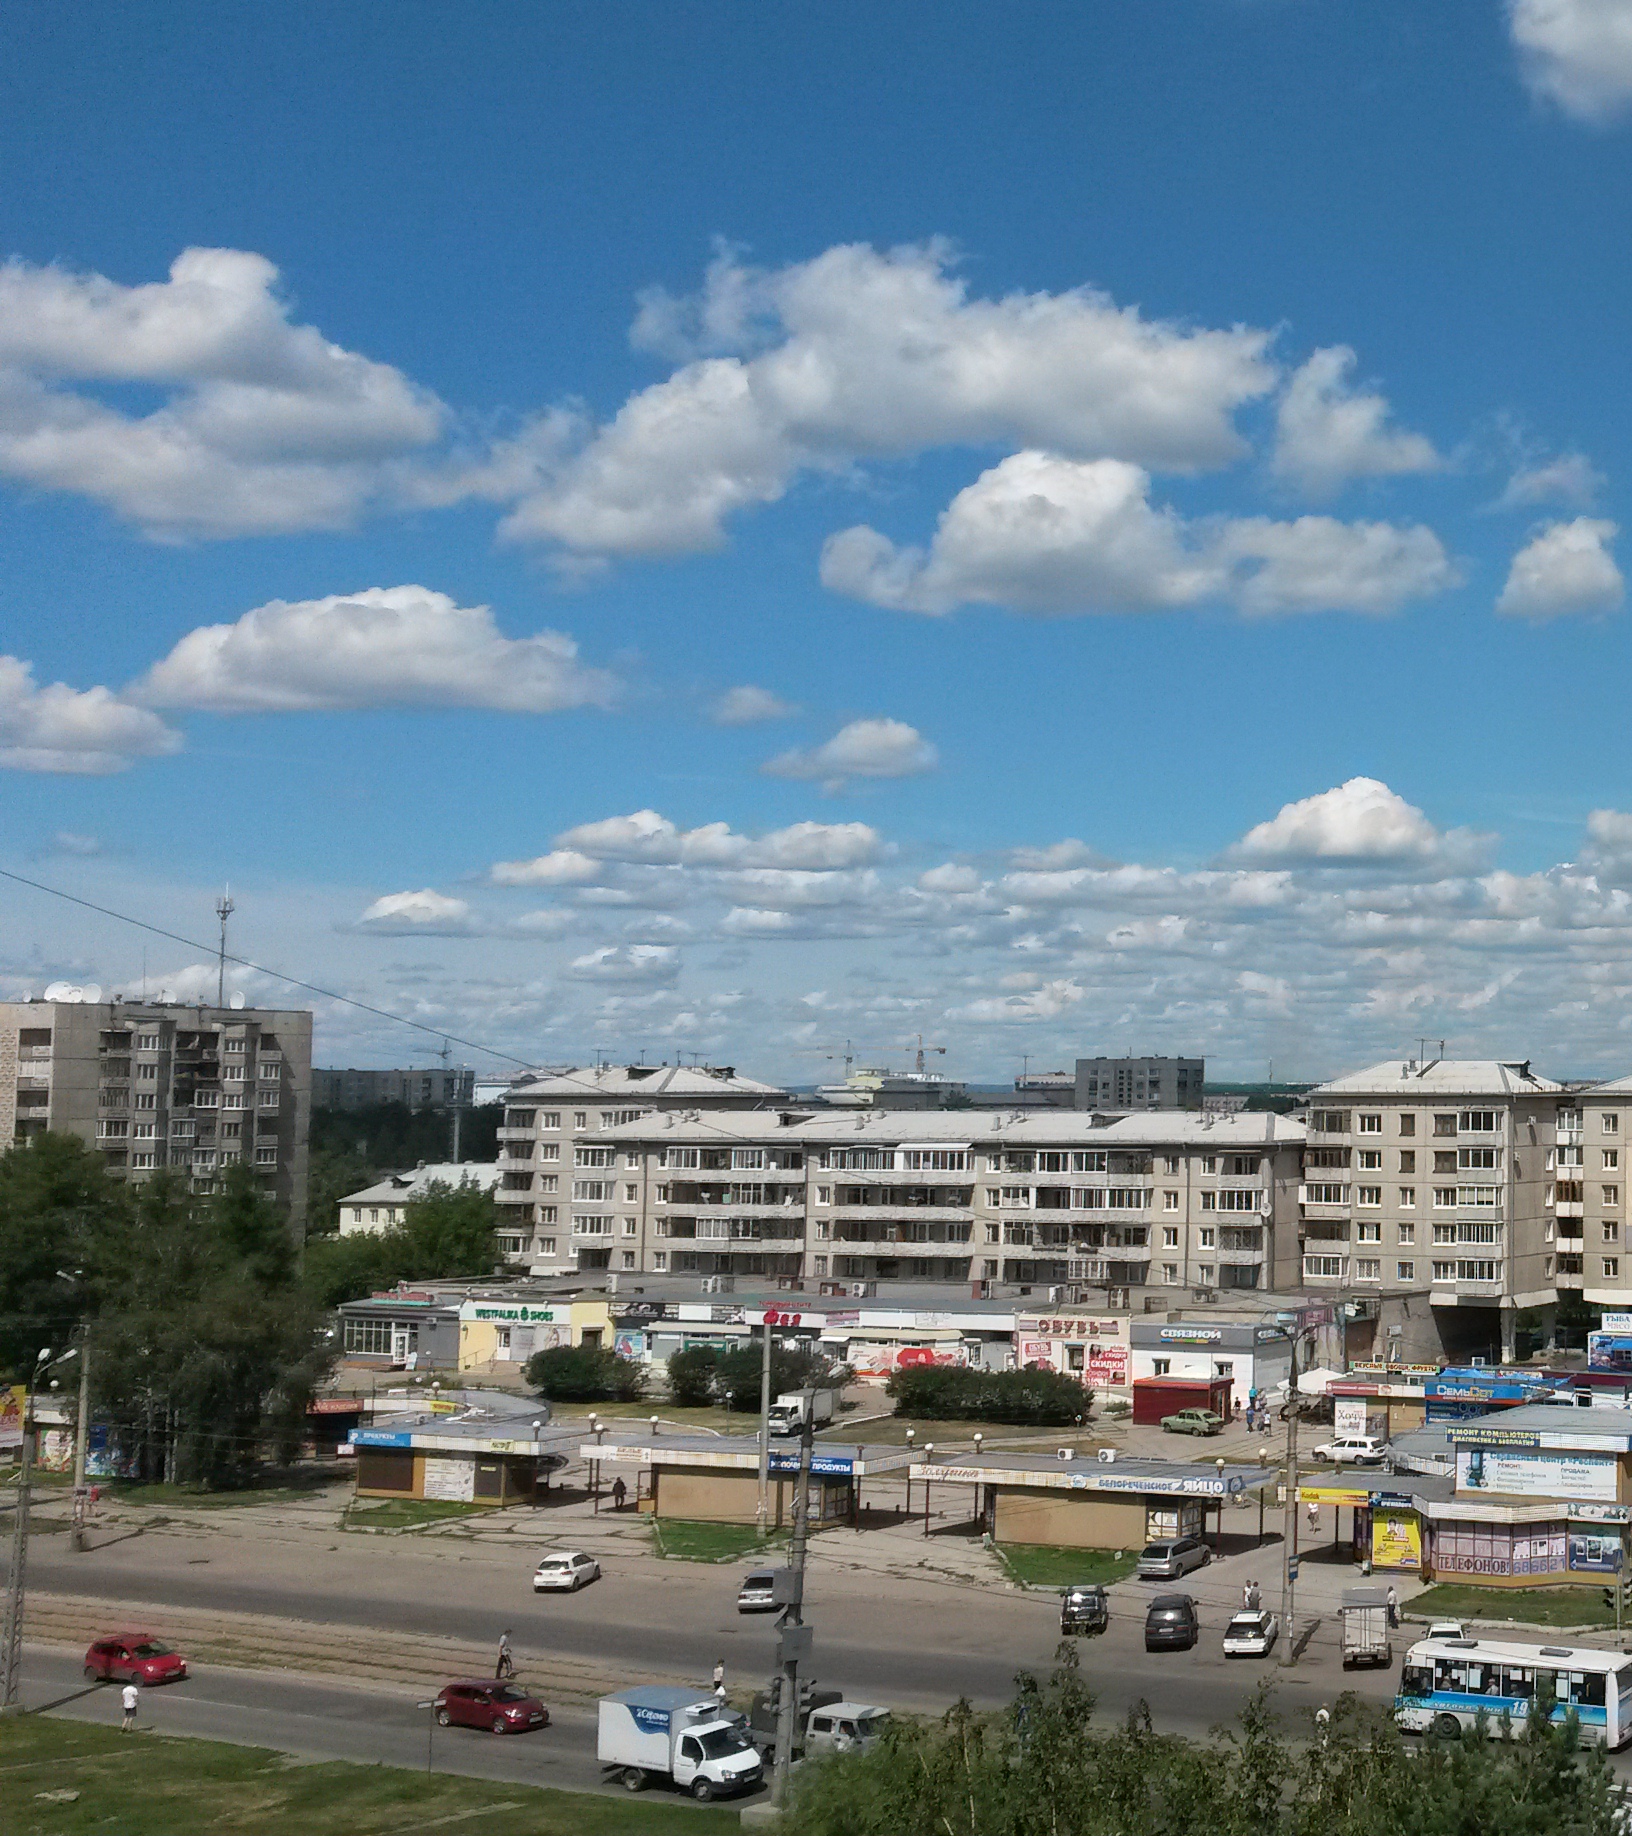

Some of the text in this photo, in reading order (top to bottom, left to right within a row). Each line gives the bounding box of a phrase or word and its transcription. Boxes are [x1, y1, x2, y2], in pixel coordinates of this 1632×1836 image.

[1039, 1320, 1099, 1334] ОБУВЬ
[1160, 1328, 1222, 1339] СВЯЗНОЙ
[1447, 1428, 1541, 1440] РЕМОНТ КОМПЬЮТЕРОВ
[812, 1463, 851, 1472] ПРОДУКТЫ
[1184, 1477, 1224, 1494] ЯЙЦО
[1439, 1556, 1510, 1574] ТЕЛЕФОНОВ!
